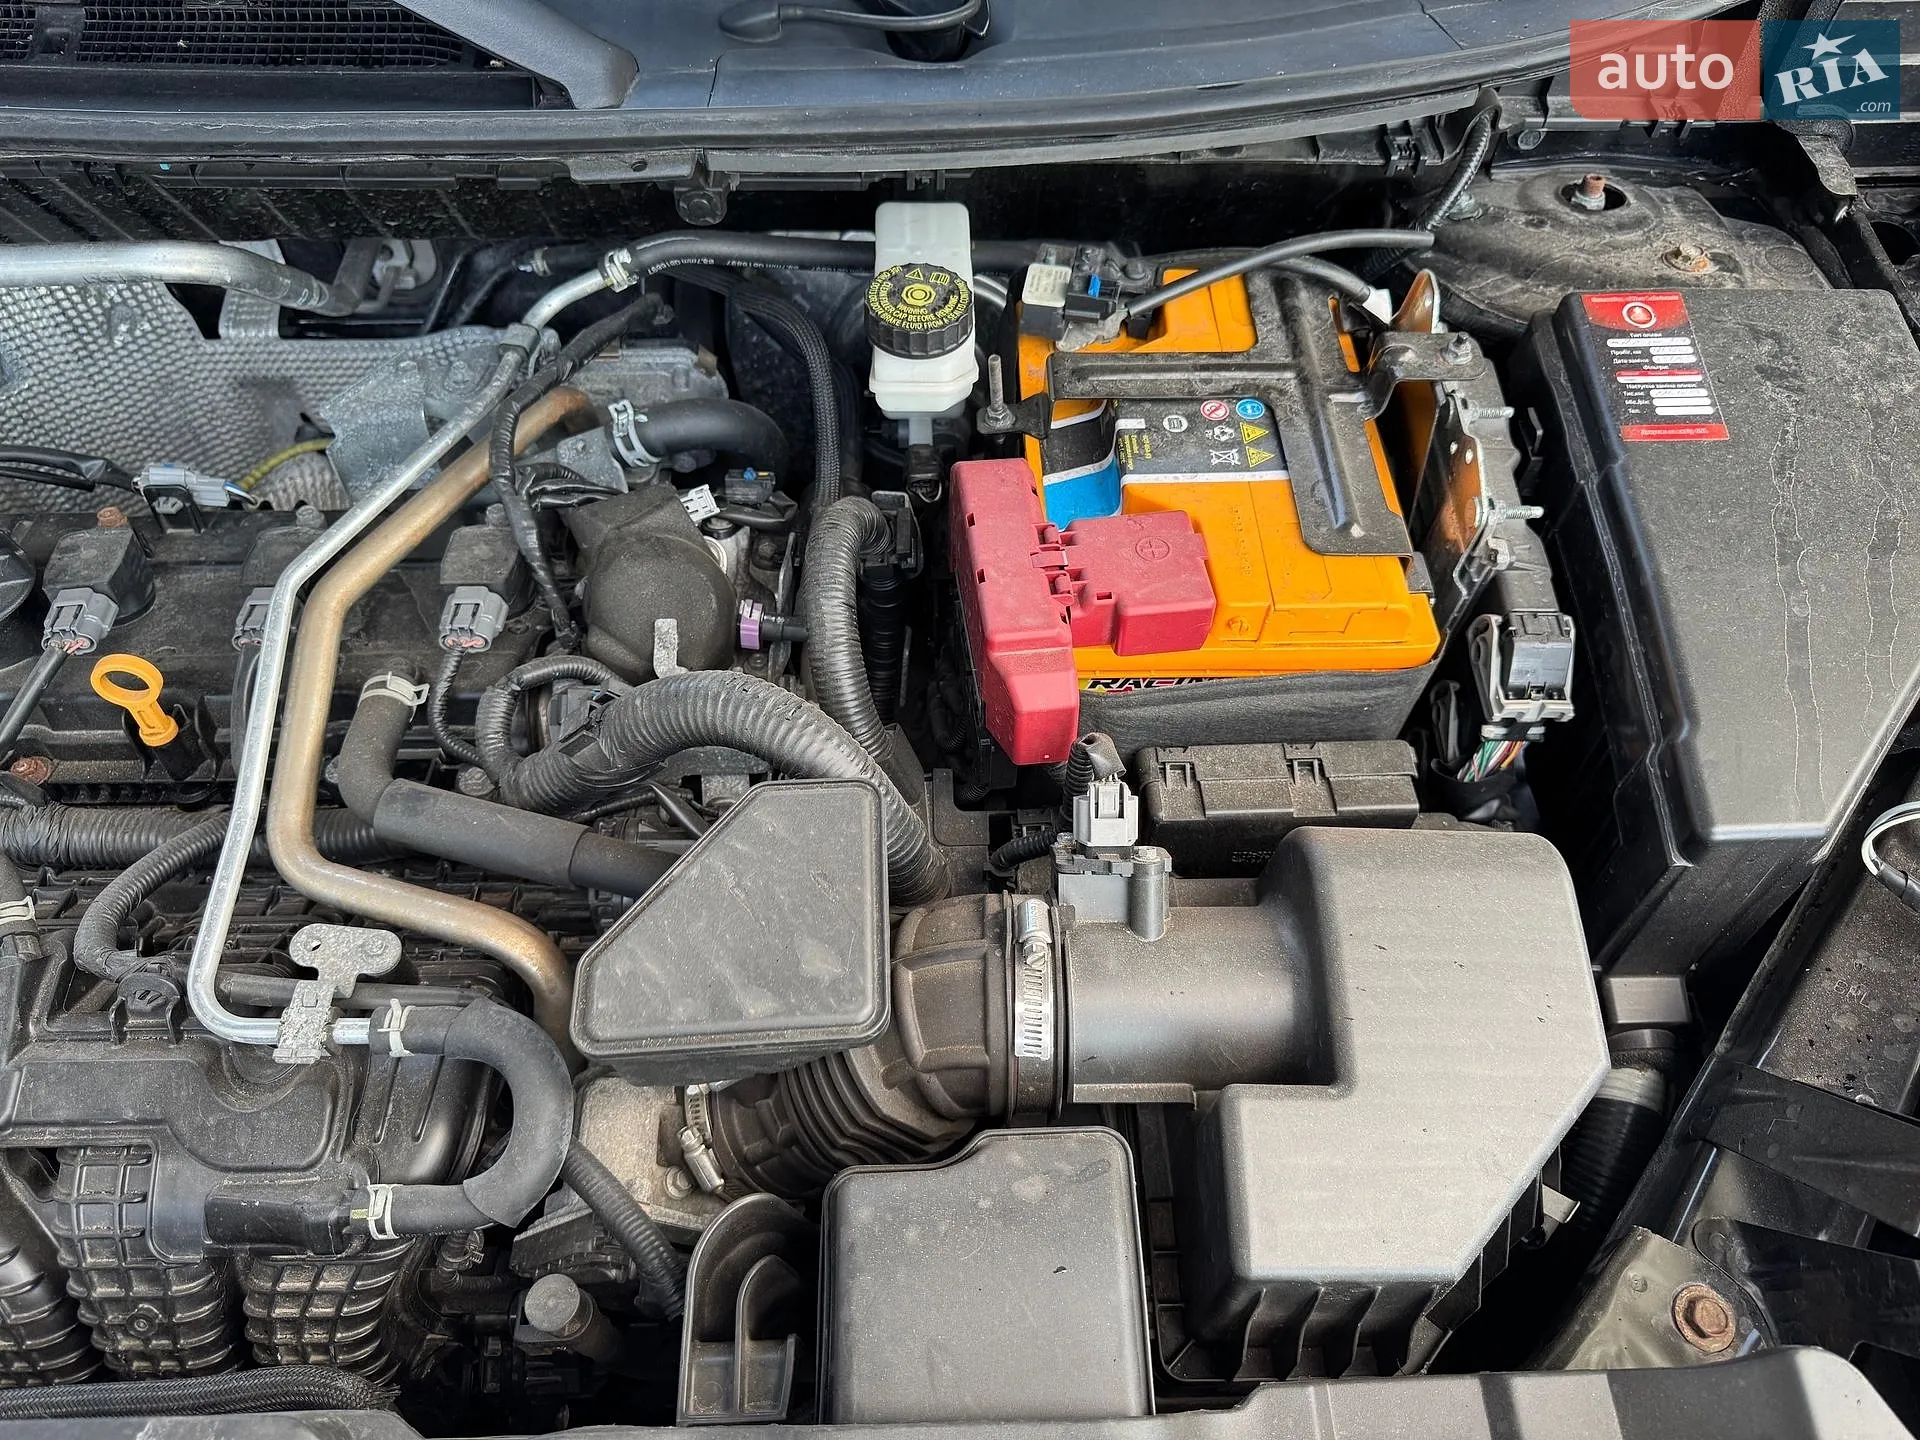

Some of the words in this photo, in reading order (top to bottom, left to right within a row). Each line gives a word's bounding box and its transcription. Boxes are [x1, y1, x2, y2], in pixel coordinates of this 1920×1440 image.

[892, 310, 908, 320] CAP
[907, 313, 936, 322] BEFORE
[935, 295, 959, 319] REMOVING
[896, 302, 928, 314] WARNING
[880, 312, 902, 327] BRAKE
[901, 320, 923, 330] FLUID
[923, 319, 944, 329] FROM
